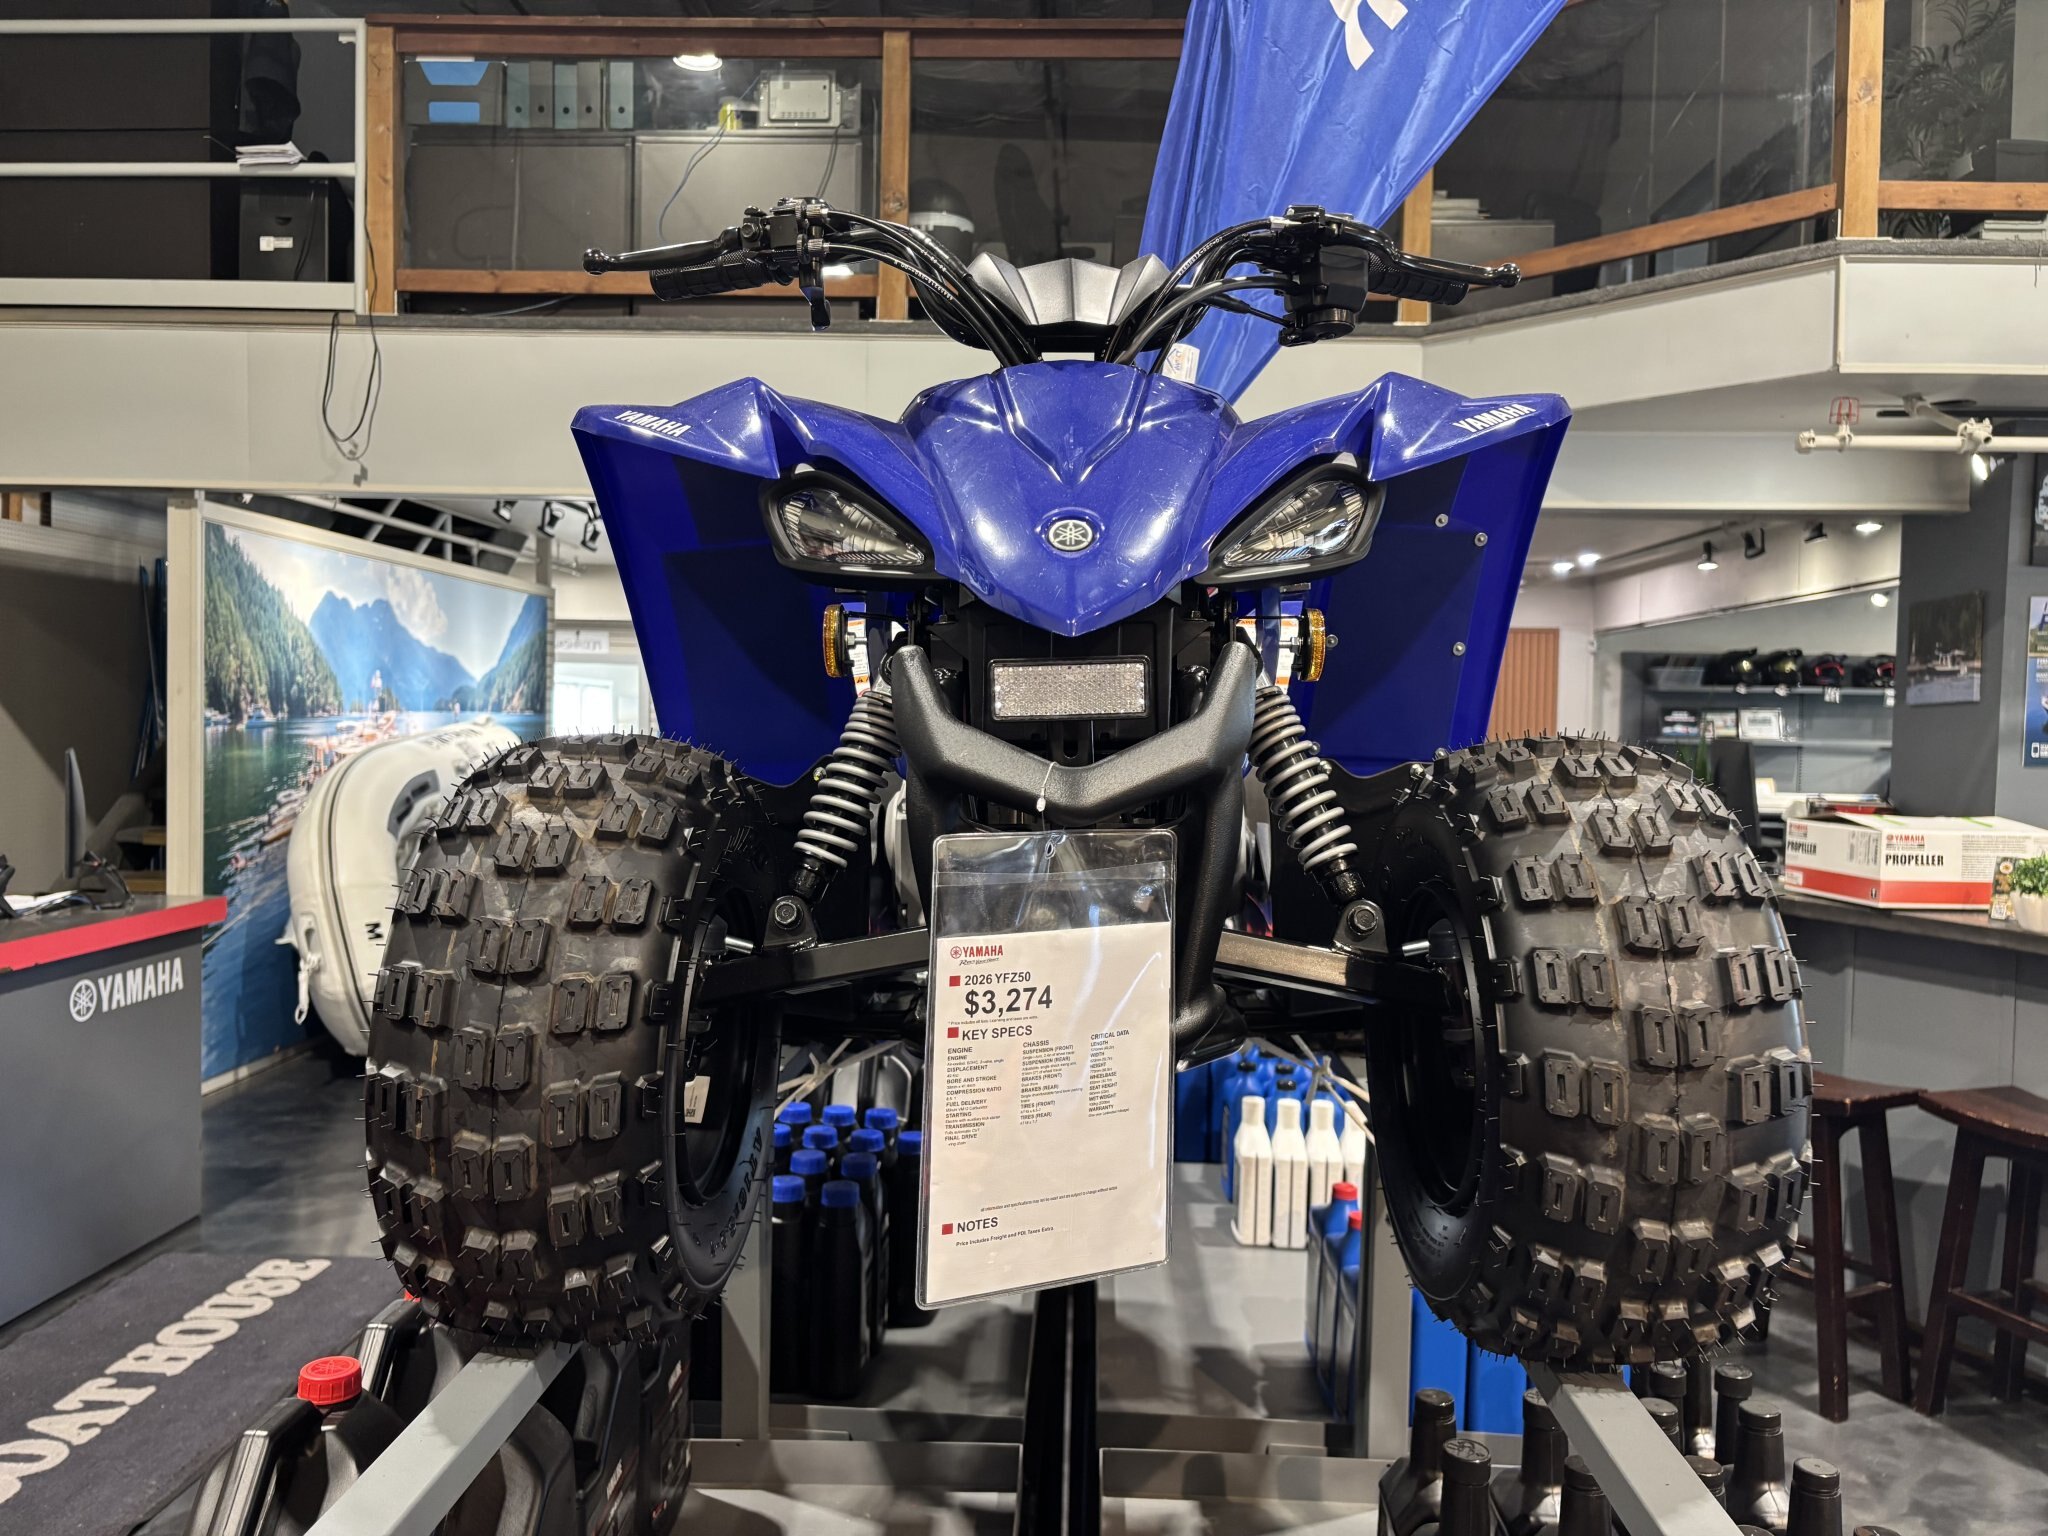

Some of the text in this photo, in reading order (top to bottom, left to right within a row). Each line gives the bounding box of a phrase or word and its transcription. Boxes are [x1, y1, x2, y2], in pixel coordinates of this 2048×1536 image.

[614, 410, 692, 437] YAMAHA
[1452, 403, 1537, 432] YAMAHA
[1895, 834, 1925, 843] YAMAHA
[1787, 840, 1817, 856] PROPELLER
[1885, 854, 1944, 867] PROPELLER
[963, 945, 1003, 958] YAMAHA
[98, 956, 184, 1013] YAMAHA
[964, 971, 1031, 986] 2026 YFZ50
[964, 985, 1053, 1018] $3,274
[962, 1025, 1033, 1041] KEY SPECS
[1090, 1032, 1115, 1040] CRITICAL
[1023, 1040, 1049, 1048] CHASSIS
[1023, 1047, 1053, 1055] SUSPENSION
[1022, 1058, 1053, 1066] SUSPENSION
[1090, 1072, 1117, 1080] WHEELBASE
[1036, 1100, 1055, 1108] (FRONT)
[957, 1216, 998, 1233] NOTES
[0, 1258, 332, 1500] OAT HOUSE
